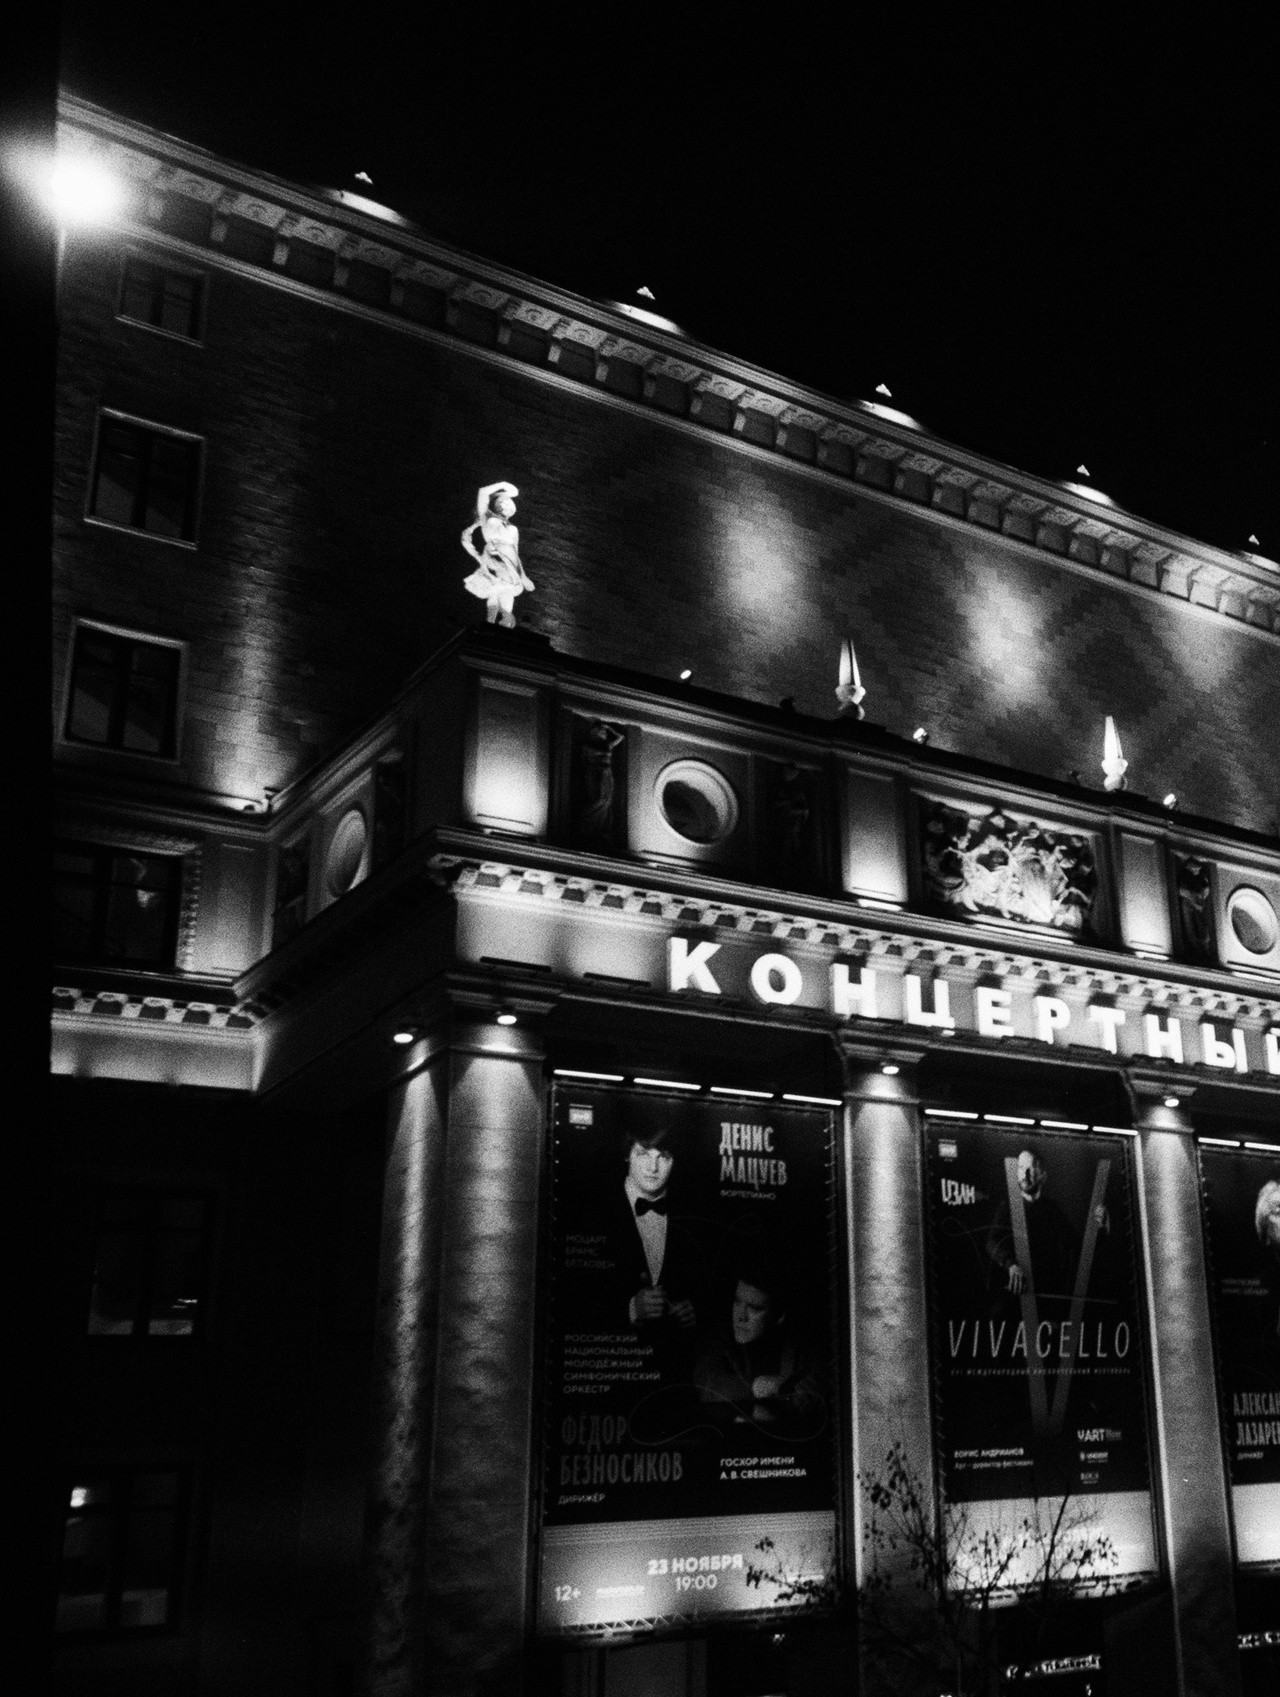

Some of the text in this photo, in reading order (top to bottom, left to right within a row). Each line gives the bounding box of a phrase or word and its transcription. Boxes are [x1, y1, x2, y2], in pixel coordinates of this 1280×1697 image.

[718, 1121, 775, 1156] ДЕНИС
[719, 1155, 788, 1191] МАЦУЕВ
[719, 1189, 777, 1201] ФОРТЕПИАНО
[564, 1332, 638, 1343] РОССИЙСКИЙ
[948, 1319, 1131, 1359] VIVACELLO
[563, 1345, 654, 1356] НАЦИОНАЛЬНЫЙ
[563, 1370, 661, 1382] СИМФОНИЧЕСКИЙ
[562, 1384, 612, 1395] ОРКЕСТР
[559, 1451, 684, 1487] БЕЗНОСИКОВ
[719, 1456, 795, 1469] ГОСХОР ИМЕНИ
[741, 1467, 808, 1480] СВЕШНИКОВА
[647, 1553, 745, 1576] 23 НОЯБРЯ
[674, 1573, 718, 1592] 19:00
[553, 1584, 582, 1602] 12+
